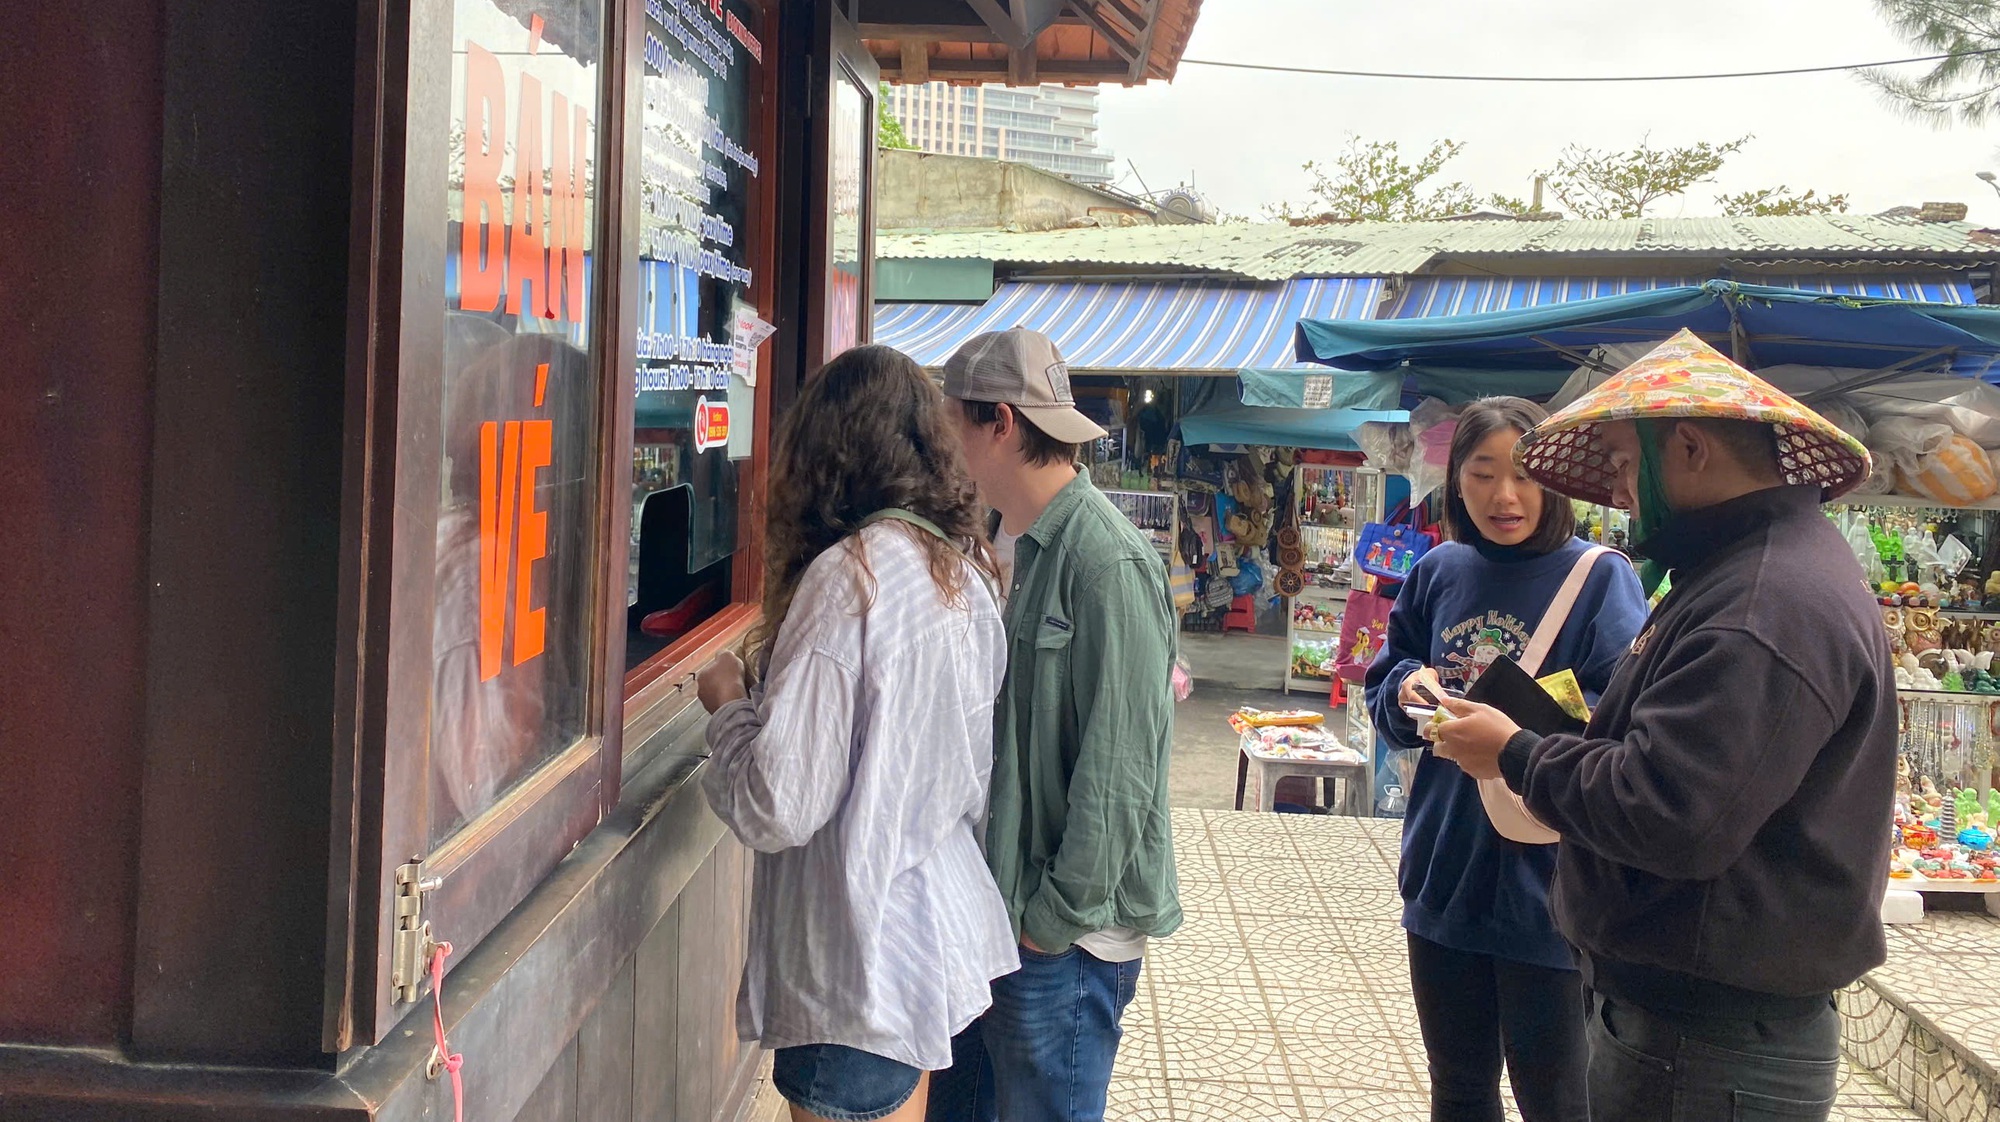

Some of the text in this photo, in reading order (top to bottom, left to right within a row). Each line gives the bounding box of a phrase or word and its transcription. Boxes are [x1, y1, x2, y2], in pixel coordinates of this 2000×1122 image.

[461, 13, 587, 322] BÁN
[652, 333, 673, 360] 7h00
[669, 364, 689, 390] 7h00
[480, 363, 552, 683] VÉ
[1441, 615, 1484, 643] Happy
